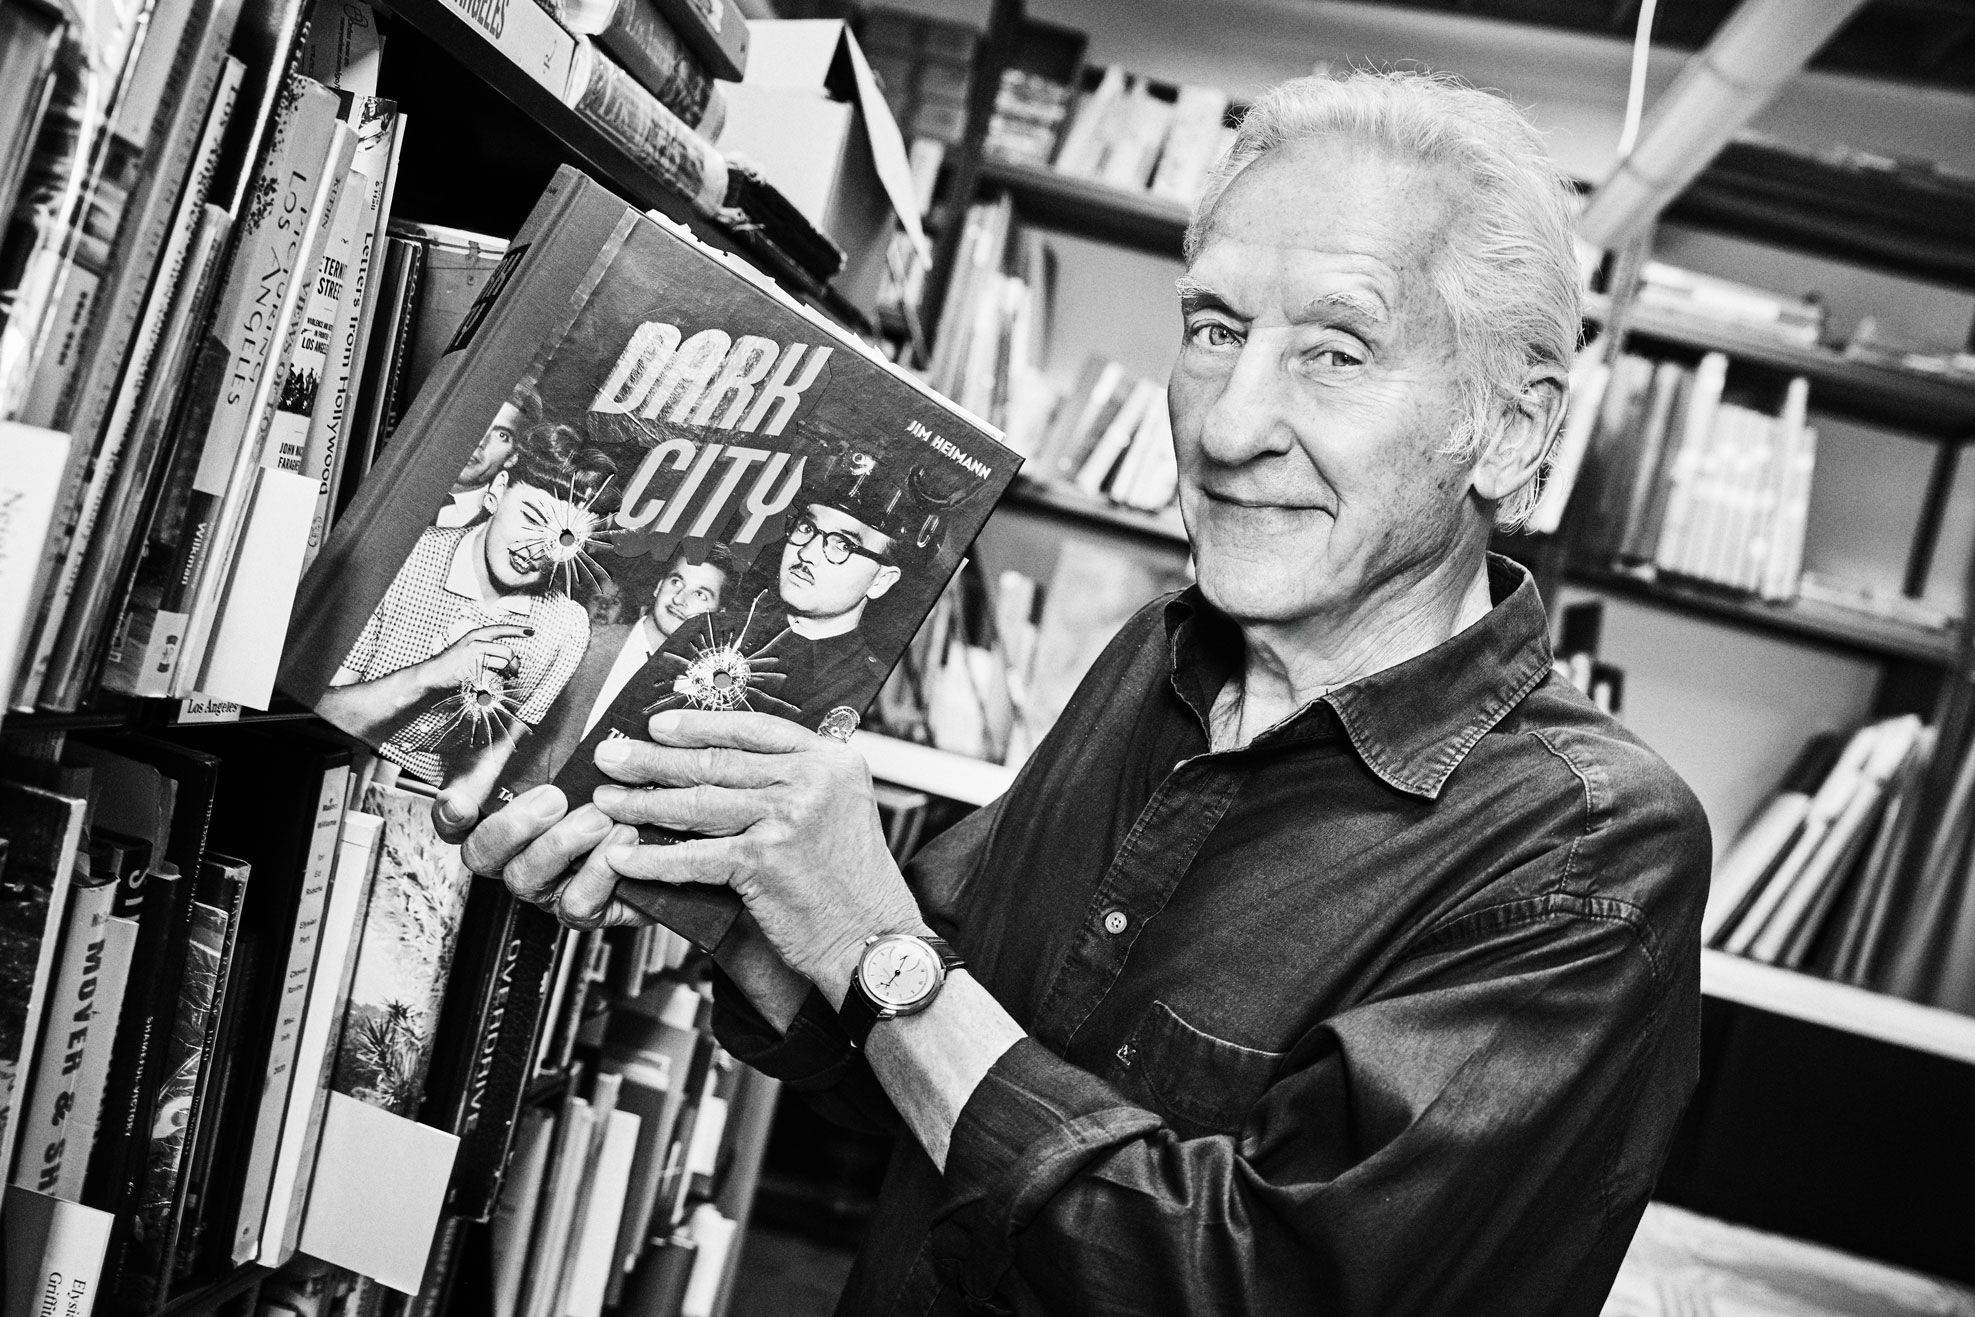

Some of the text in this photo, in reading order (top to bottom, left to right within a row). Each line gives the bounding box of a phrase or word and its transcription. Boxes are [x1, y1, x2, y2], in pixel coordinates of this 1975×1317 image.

[278, 171, 306, 230] LOS
[317, 277, 342, 301] STREE
[228, 246, 281, 404] ANGELES
[301, 337, 315, 351] LOS
[319, 233, 373, 495] Letters from Hollywood
[587, 321, 834, 436] DARK
[905, 420, 992, 481] JIM HEIMANN
[614, 438, 807, 545] CITY
[181, 522, 208, 585] Wilkman
[187, 699, 238, 719] Los Angeles
[62, 938, 106, 1076] MOVER
[51, 1090, 75, 1128] &
